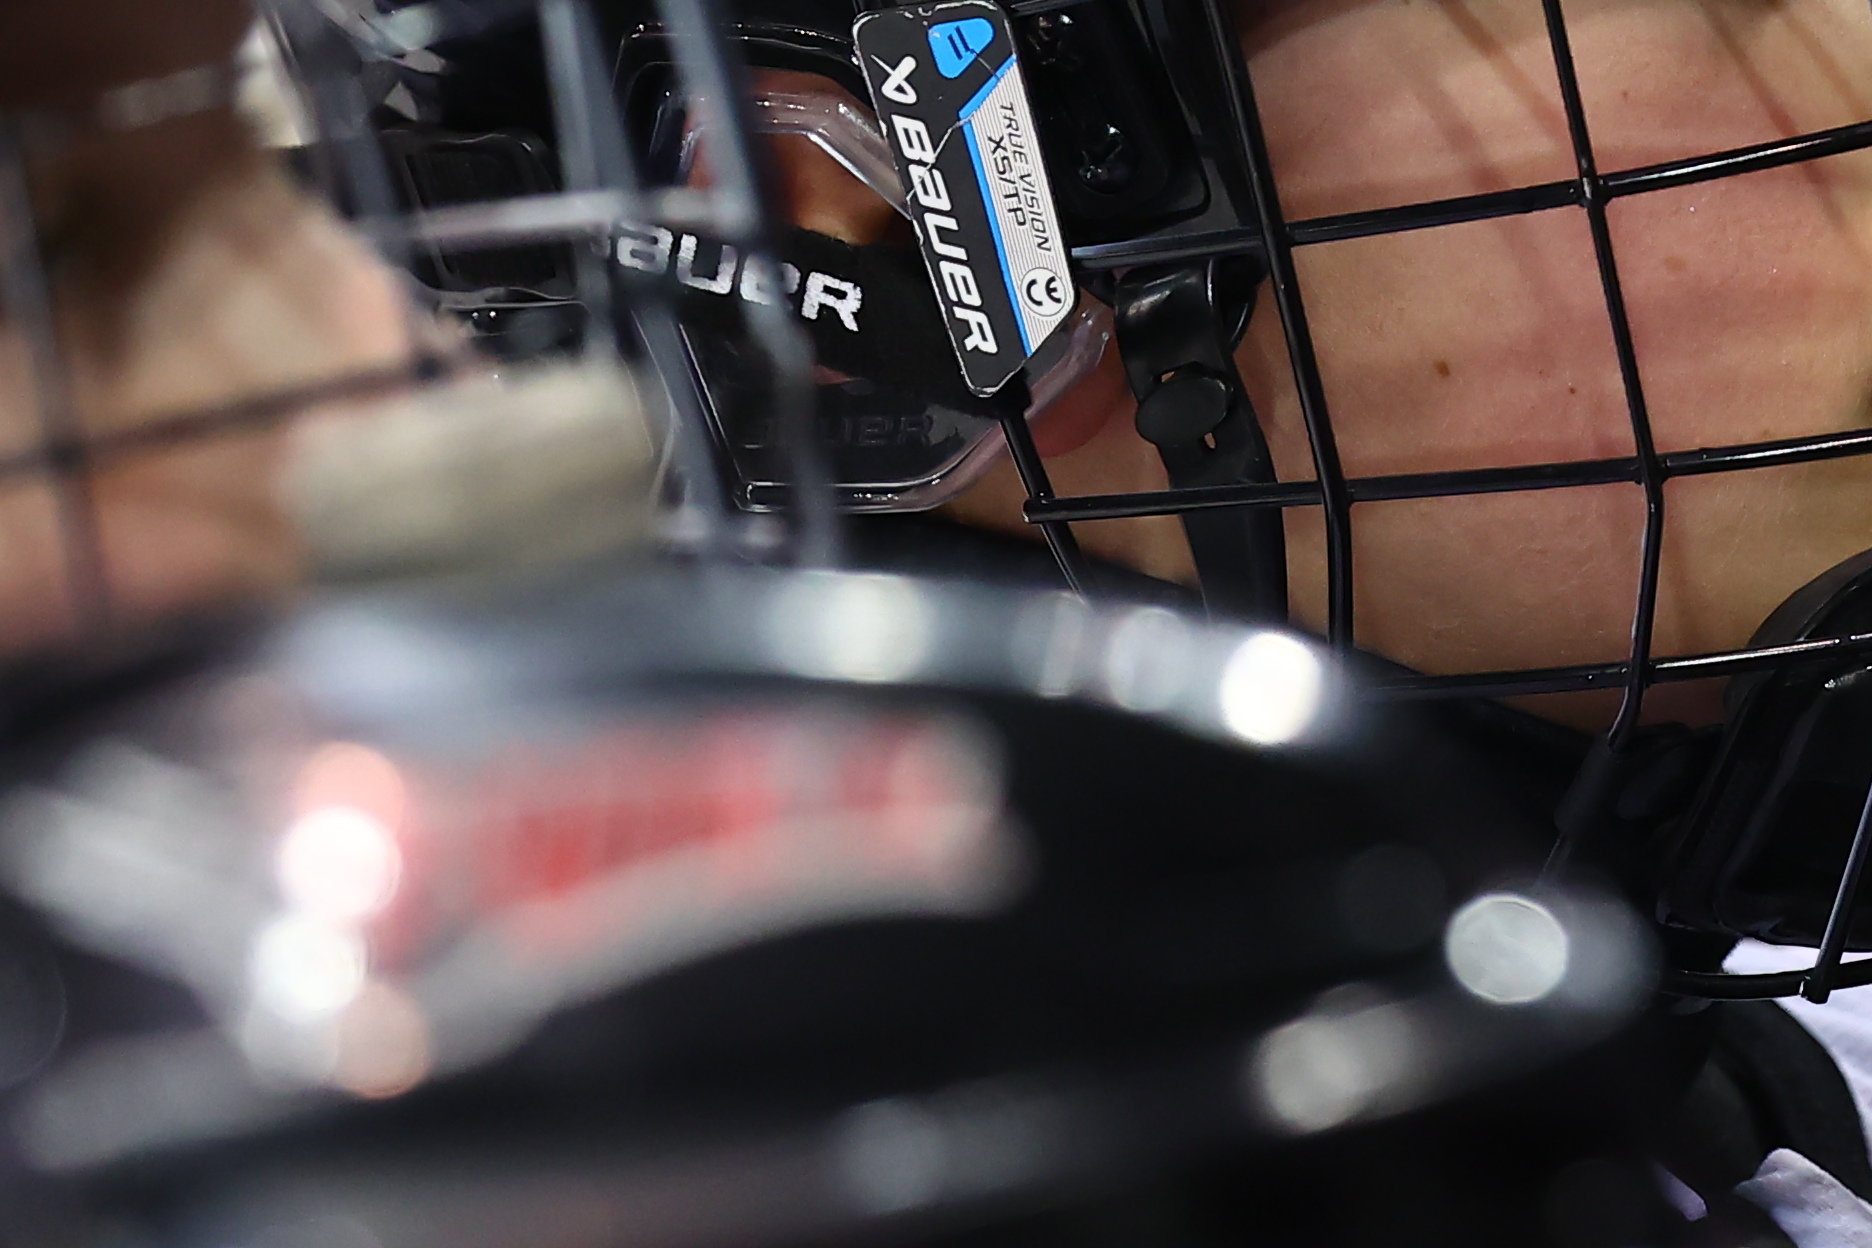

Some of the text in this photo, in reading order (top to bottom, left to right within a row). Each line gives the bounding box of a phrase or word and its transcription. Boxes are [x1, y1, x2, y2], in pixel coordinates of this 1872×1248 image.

[891, 113, 999, 355] BAUER
[986, 134, 1028, 227] XS/TP
[1000, 101, 1053, 253] TRUE VISION
[594, 220, 864, 333] AUER
